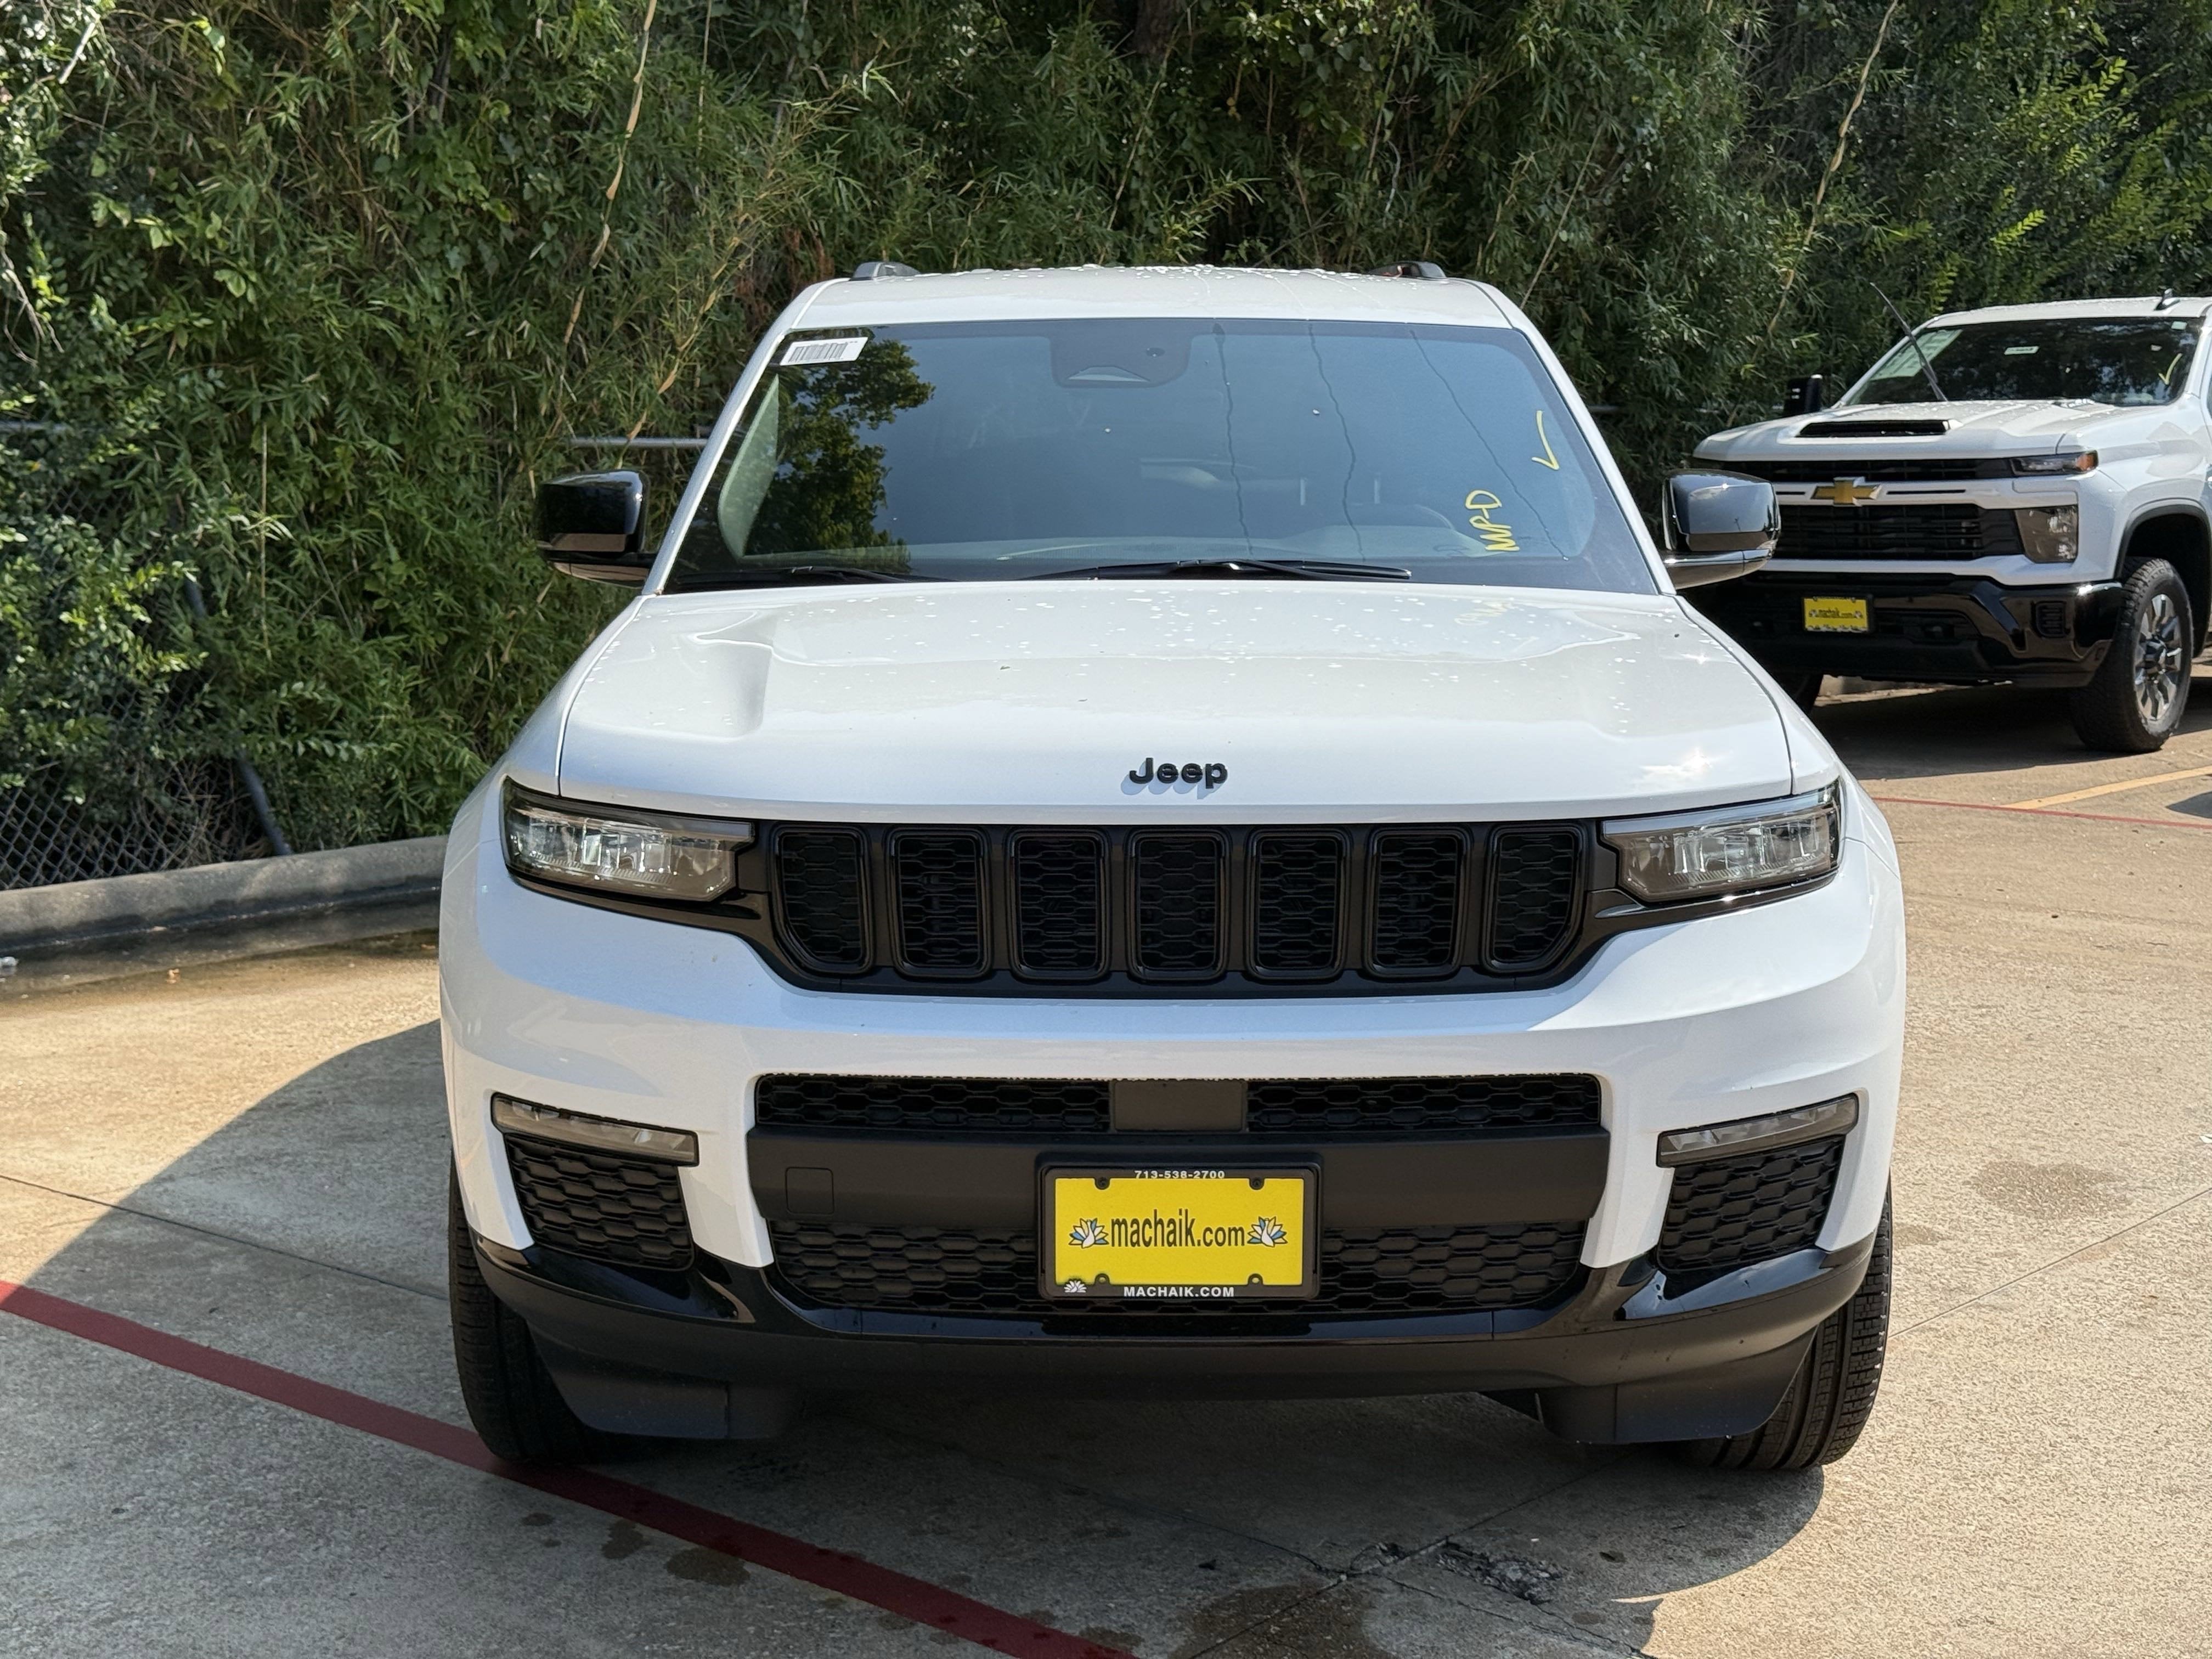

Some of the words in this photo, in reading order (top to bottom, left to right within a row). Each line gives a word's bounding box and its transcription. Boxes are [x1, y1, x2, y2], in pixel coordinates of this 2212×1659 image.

[1129, 757, 1228, 789] Jeep
[1134, 1170, 1226, 1180] 713-538-2700
[1110, 1208, 1245, 1248] machaik.com
[1123, 1286, 1234, 1298] MACHAIK.COM
